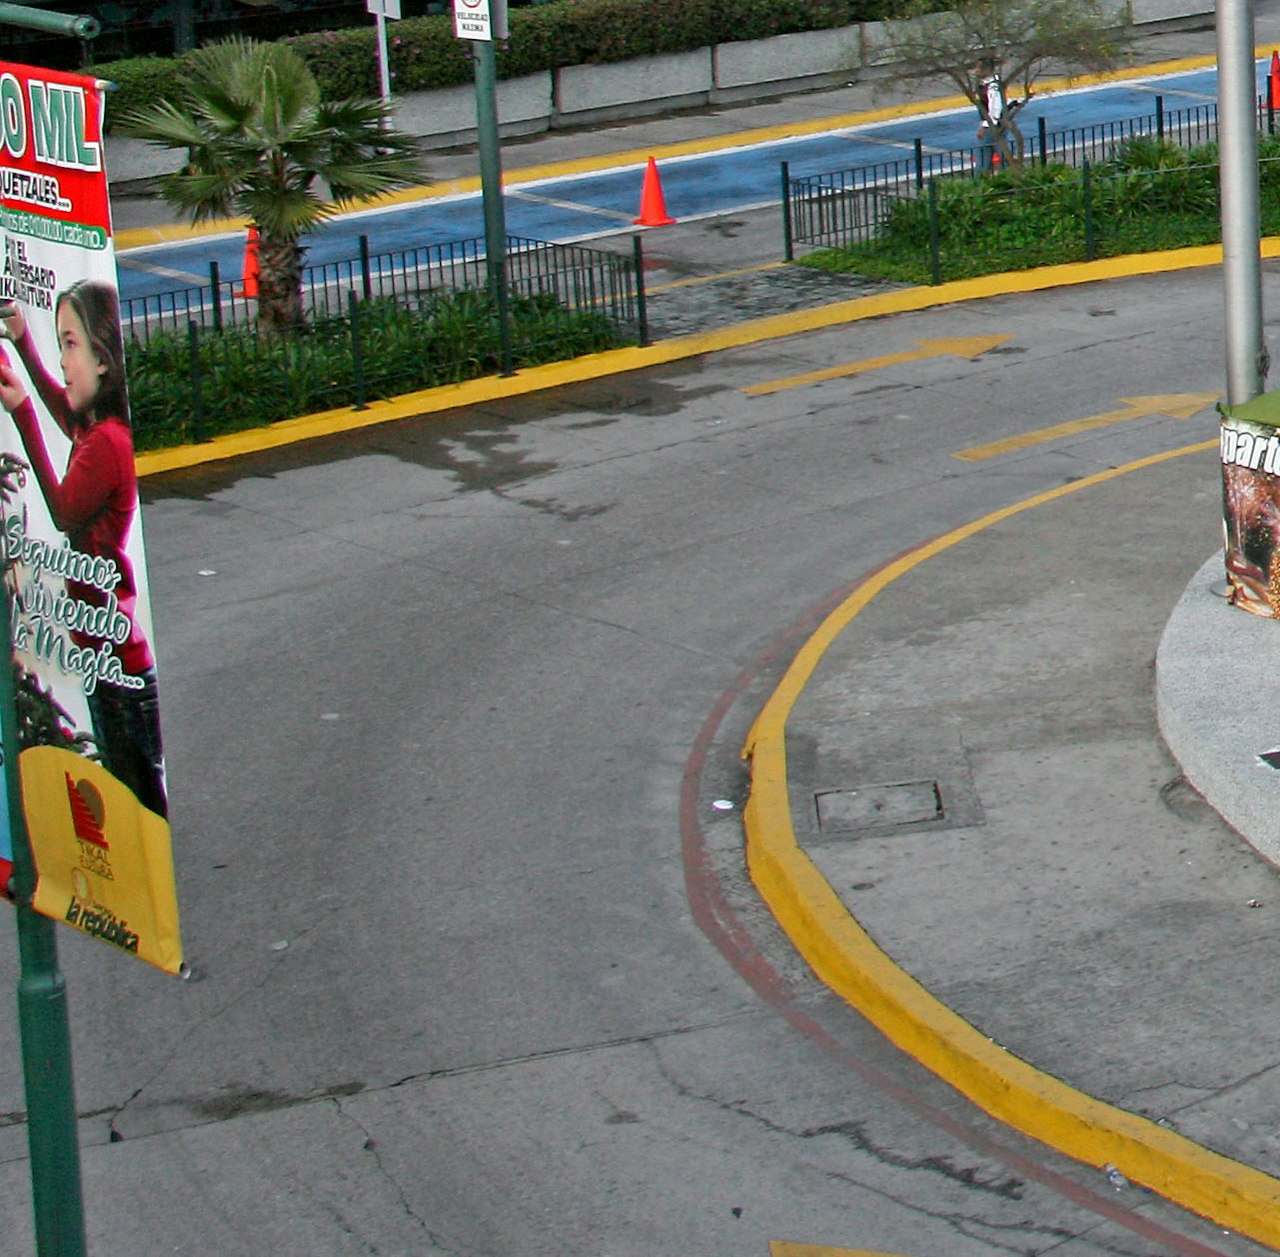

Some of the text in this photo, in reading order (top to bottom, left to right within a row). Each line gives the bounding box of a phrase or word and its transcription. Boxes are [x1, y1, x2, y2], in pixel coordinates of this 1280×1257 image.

[28, 79, 102, 172] MIL
[0, 167, 73, 213] UETZALES...
[6, 514, 122, 590] Seguimos
[22, 581, 131, 645] viviendo
